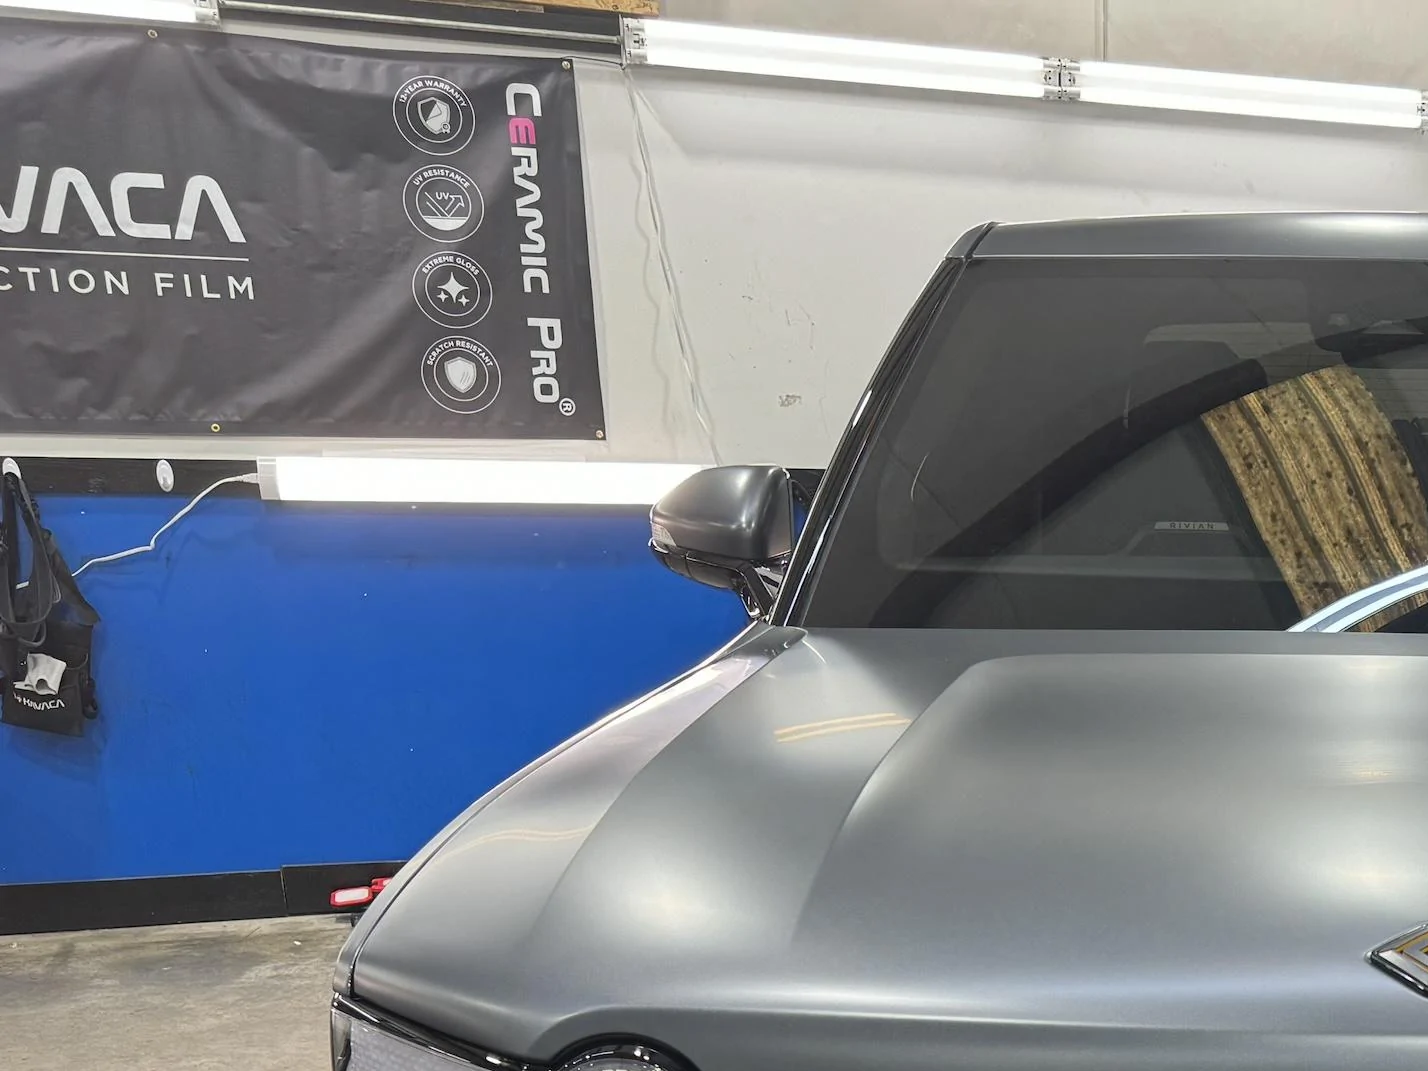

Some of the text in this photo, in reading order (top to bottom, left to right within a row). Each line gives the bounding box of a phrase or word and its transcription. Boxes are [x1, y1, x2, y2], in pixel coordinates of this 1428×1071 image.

[424, 79, 468, 108] WARRANTY
[413, 168, 471, 189] UV RESISTANCE
[505, 82, 550, 294] CERAMIC
[435, 191, 450, 200] UV
[422, 255, 480, 276] EXTREME GLOSS
[154, 272, 255, 300] FILM
[426, 339, 494, 367] SCRATCH RESISTANT
